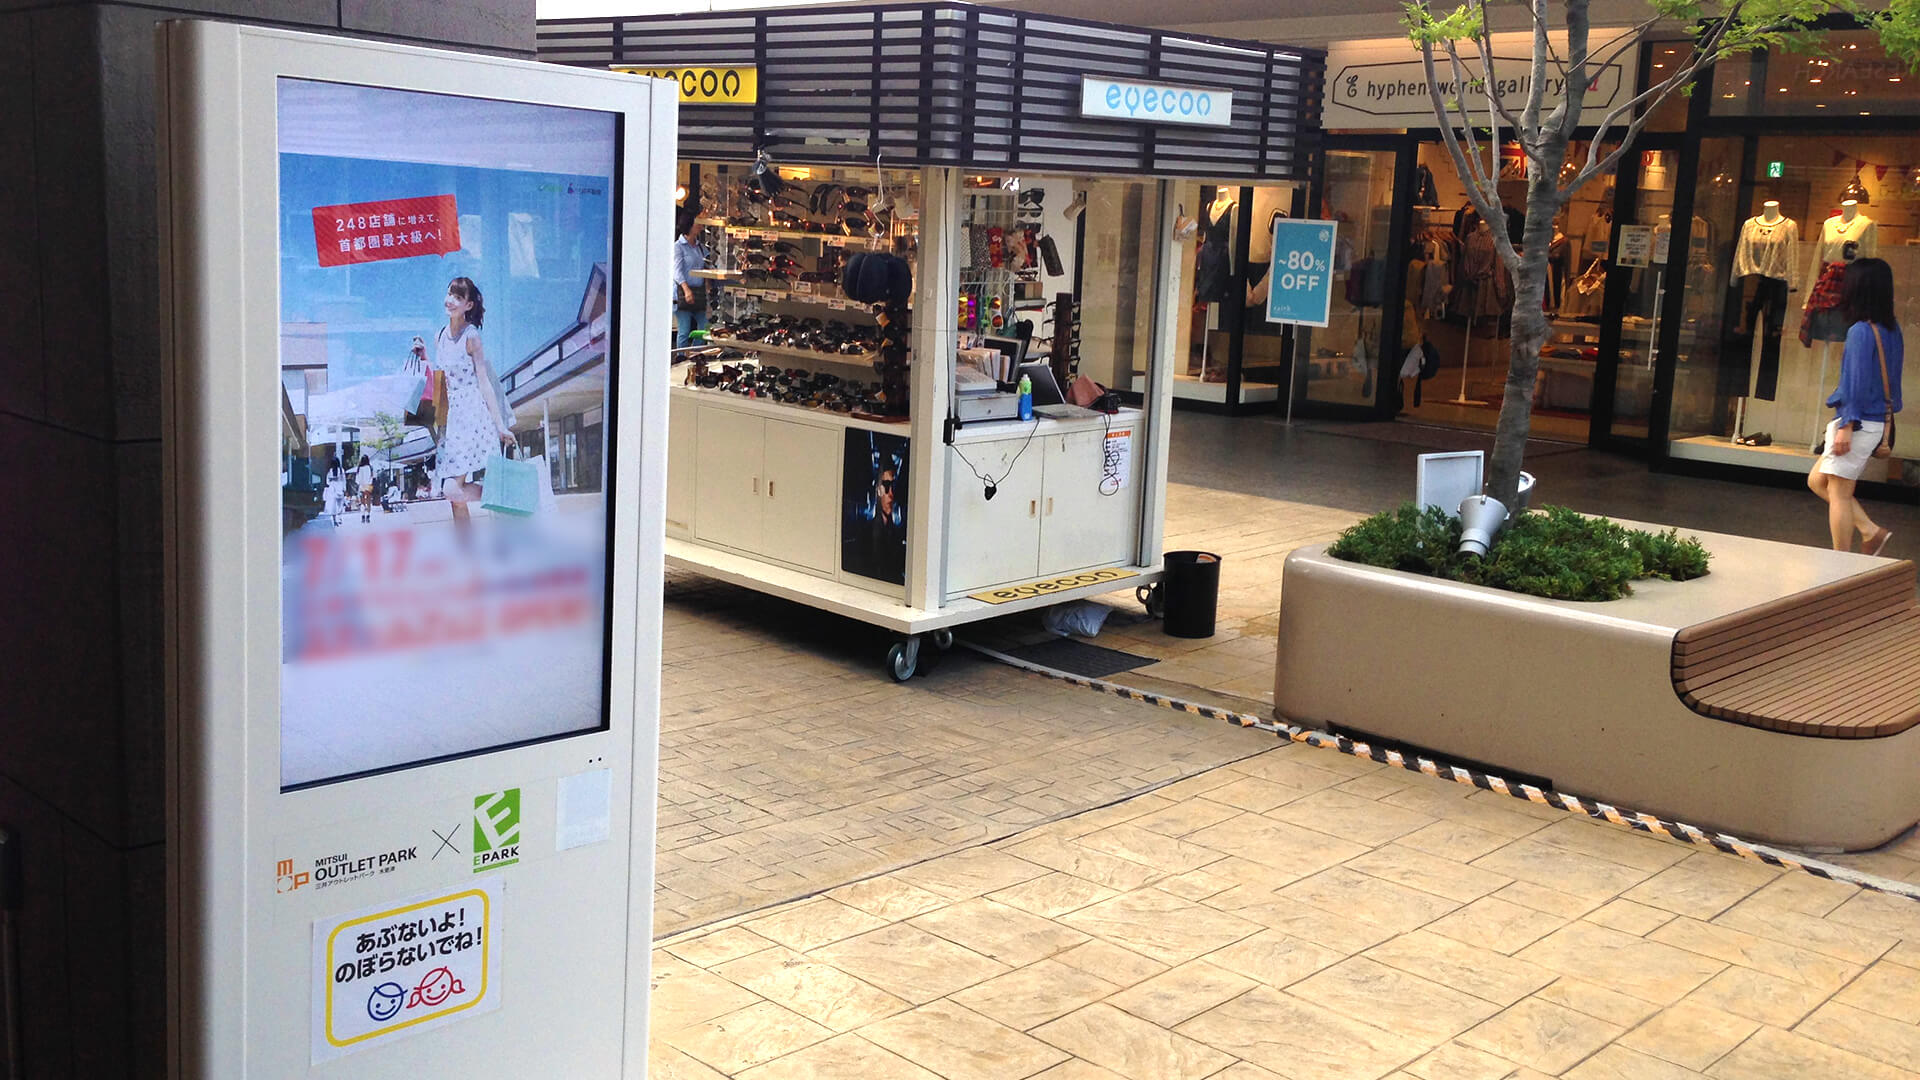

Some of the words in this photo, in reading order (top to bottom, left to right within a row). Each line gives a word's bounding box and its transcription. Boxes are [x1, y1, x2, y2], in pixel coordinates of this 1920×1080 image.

[1367, 76, 1426, 99] hyphen
[1497, 75, 1565, 97] gallry
[1106, 84, 1211, 116] eyecon
[1281, 273, 1320, 292] OFF
[315, 853, 348, 867] MITSUI
[315, 856, 376, 881] OUTLET
[378, 847, 417, 867] PARK
[474, 845, 519, 866] EPARK
[335, 927, 482, 984] のぼらないでね!
